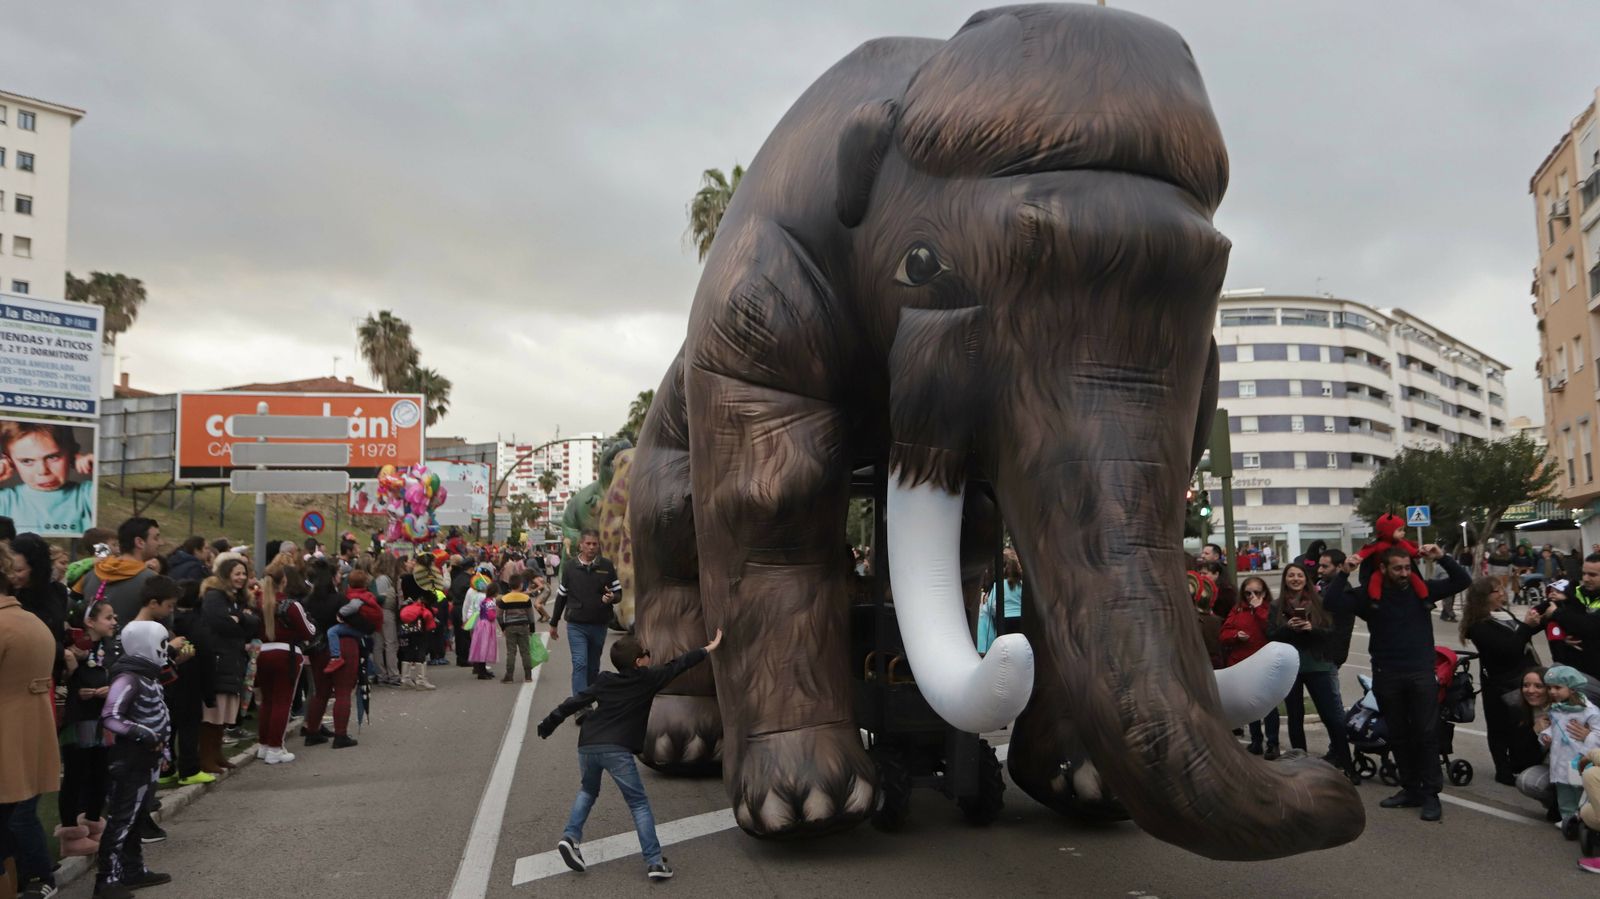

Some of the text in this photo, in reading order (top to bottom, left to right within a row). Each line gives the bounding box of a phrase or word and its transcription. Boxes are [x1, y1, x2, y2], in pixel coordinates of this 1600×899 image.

[6, 306, 19, 319] la
[0, 331, 44, 346] IENDAS
[46, 337, 53, 346] Y
[30, 348, 89, 362] DORMITORIOS
[14, 395, 39, 407] 952
[40, 397, 63, 409] 541
[65, 399, 89, 411] 800
[359, 443, 397, 457] 1978
